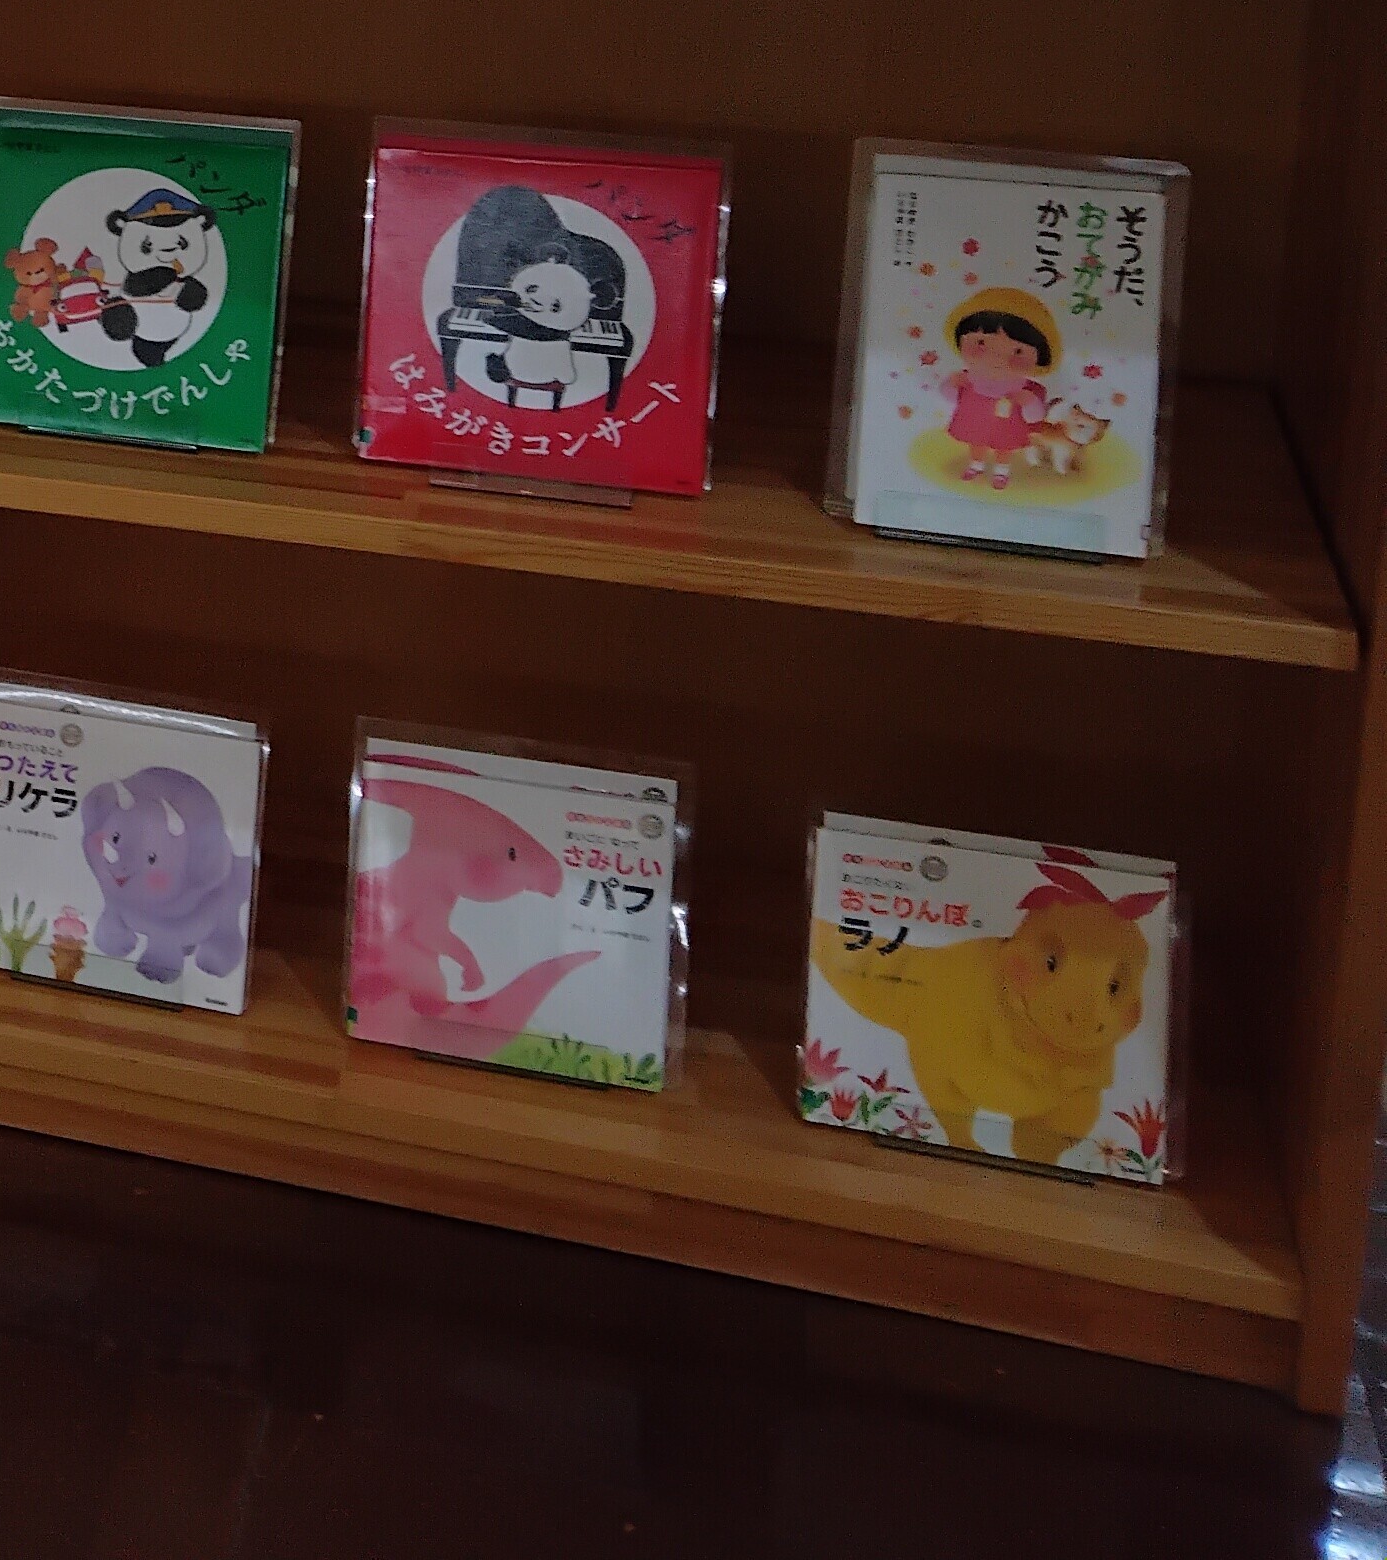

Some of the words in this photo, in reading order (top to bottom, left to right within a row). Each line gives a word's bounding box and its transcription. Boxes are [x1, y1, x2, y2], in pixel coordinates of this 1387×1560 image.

[1035, 199, 1069, 289] かこう
[1070, 200, 1109, 320] おてがみ
[1113, 205, 1148, 307] そうだ、
[387, 353, 682, 458] はみがきコンサート
[562, 844, 664, 878] さみしい
